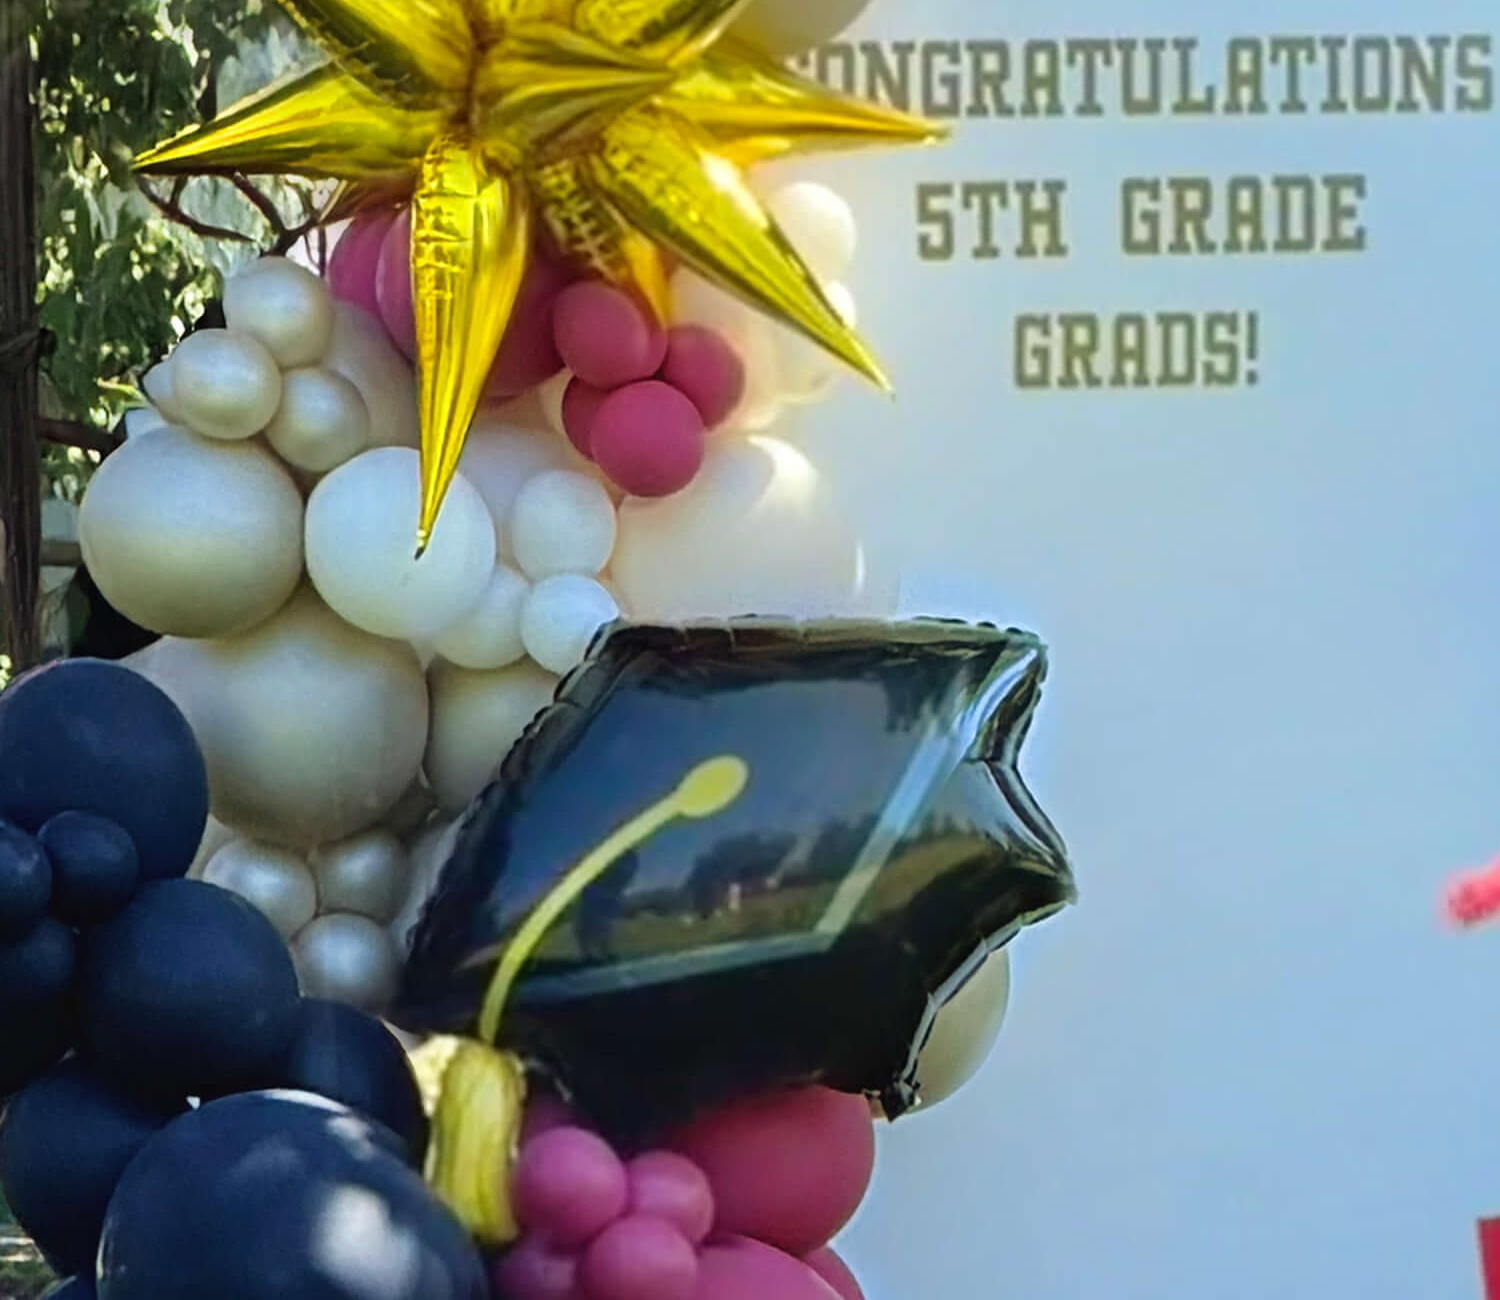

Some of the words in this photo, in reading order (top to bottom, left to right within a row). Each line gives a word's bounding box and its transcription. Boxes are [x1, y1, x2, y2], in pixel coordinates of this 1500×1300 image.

[790, 35, 1494, 118] ONGRATULATIONS
[914, 180, 1068, 261] 5TH
[1120, 173, 1368, 256] GRADE
[1013, 310, 1260, 390] GRADS!
